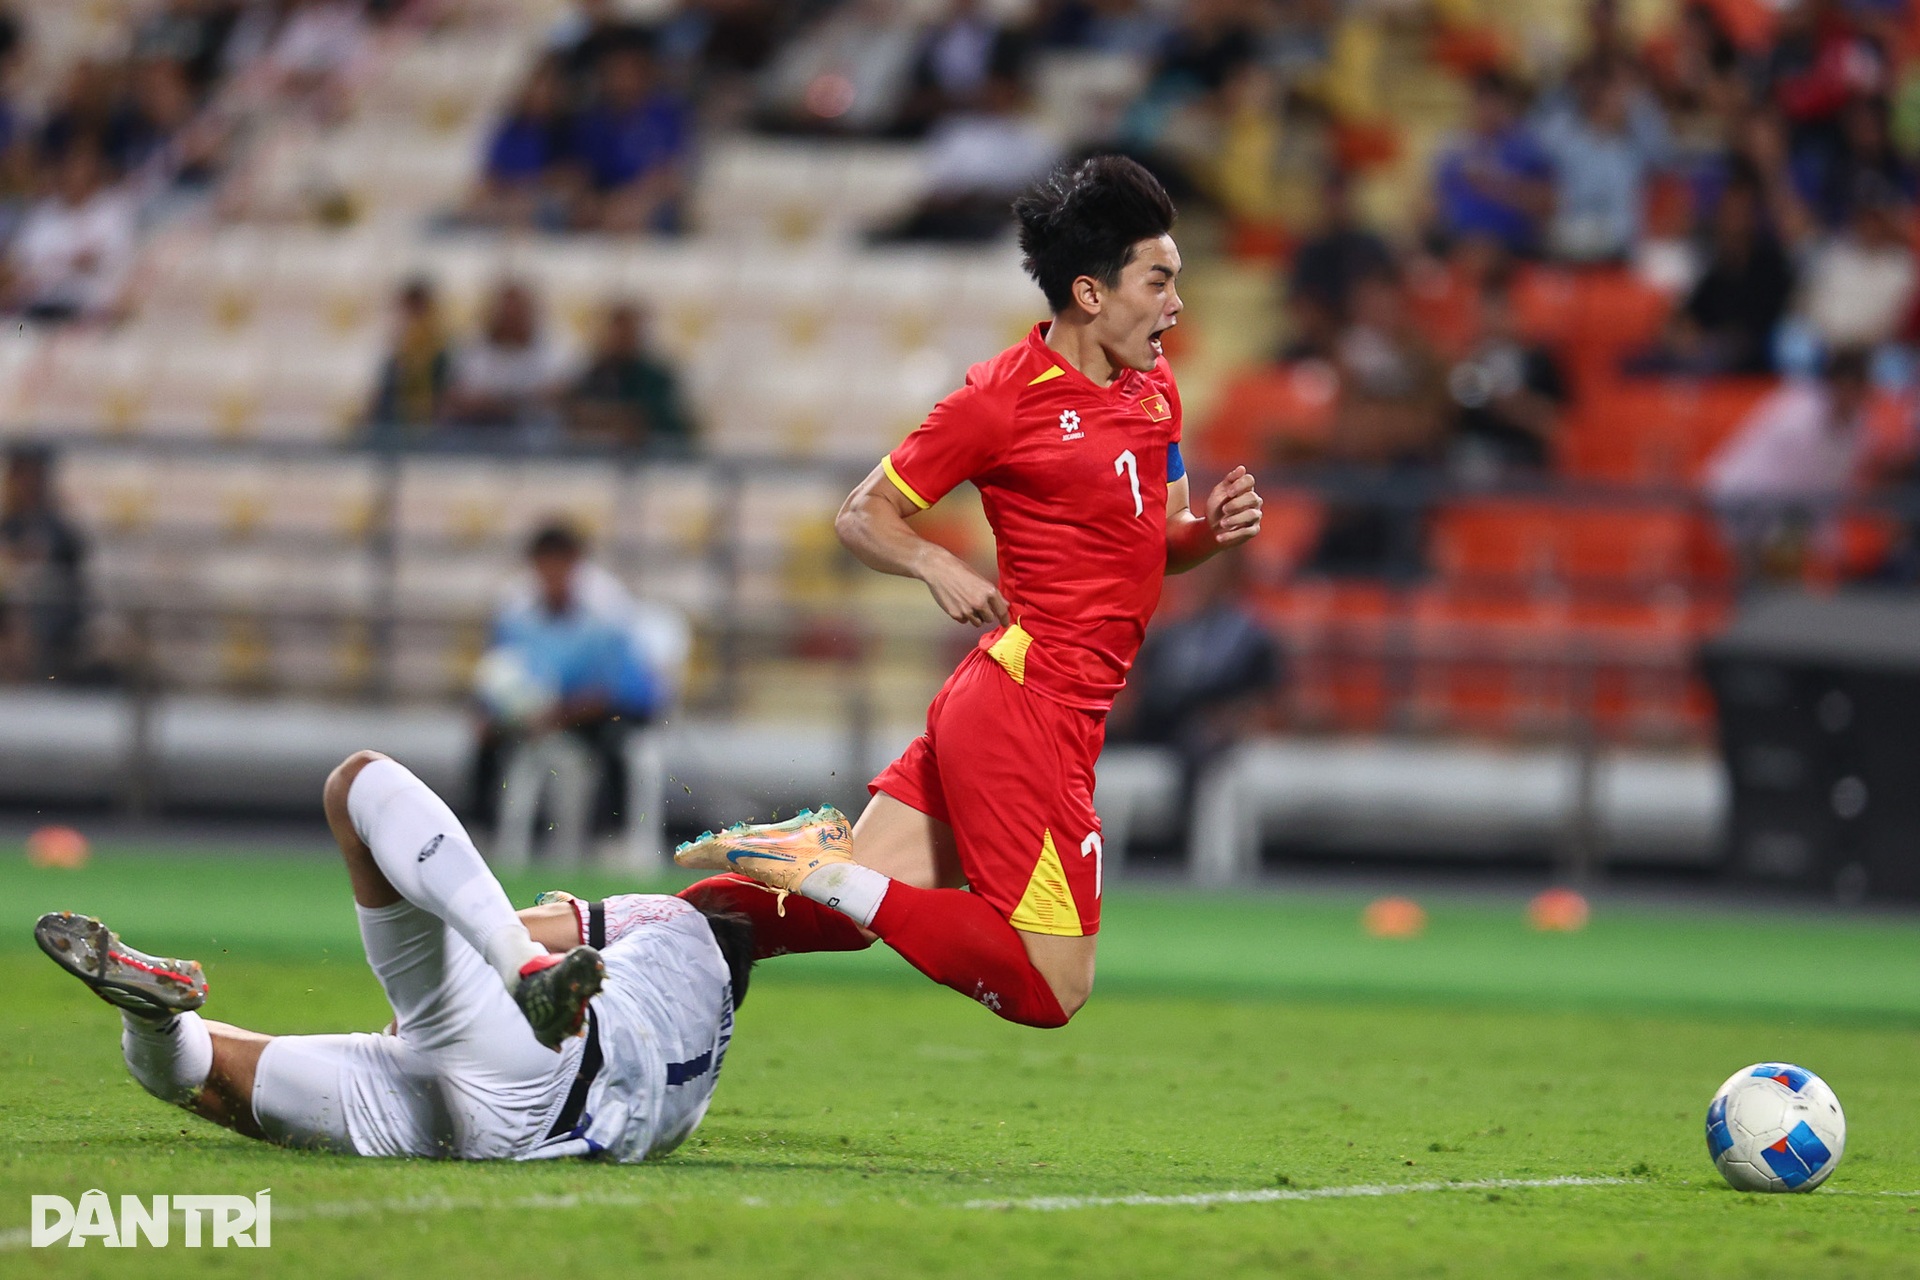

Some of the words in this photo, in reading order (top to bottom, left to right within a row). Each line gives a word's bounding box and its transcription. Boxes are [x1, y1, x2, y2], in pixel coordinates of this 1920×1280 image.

[1114, 448, 1143, 518] 7
[1080, 830, 1102, 900] 7
[666, 1050, 713, 1086] 1
